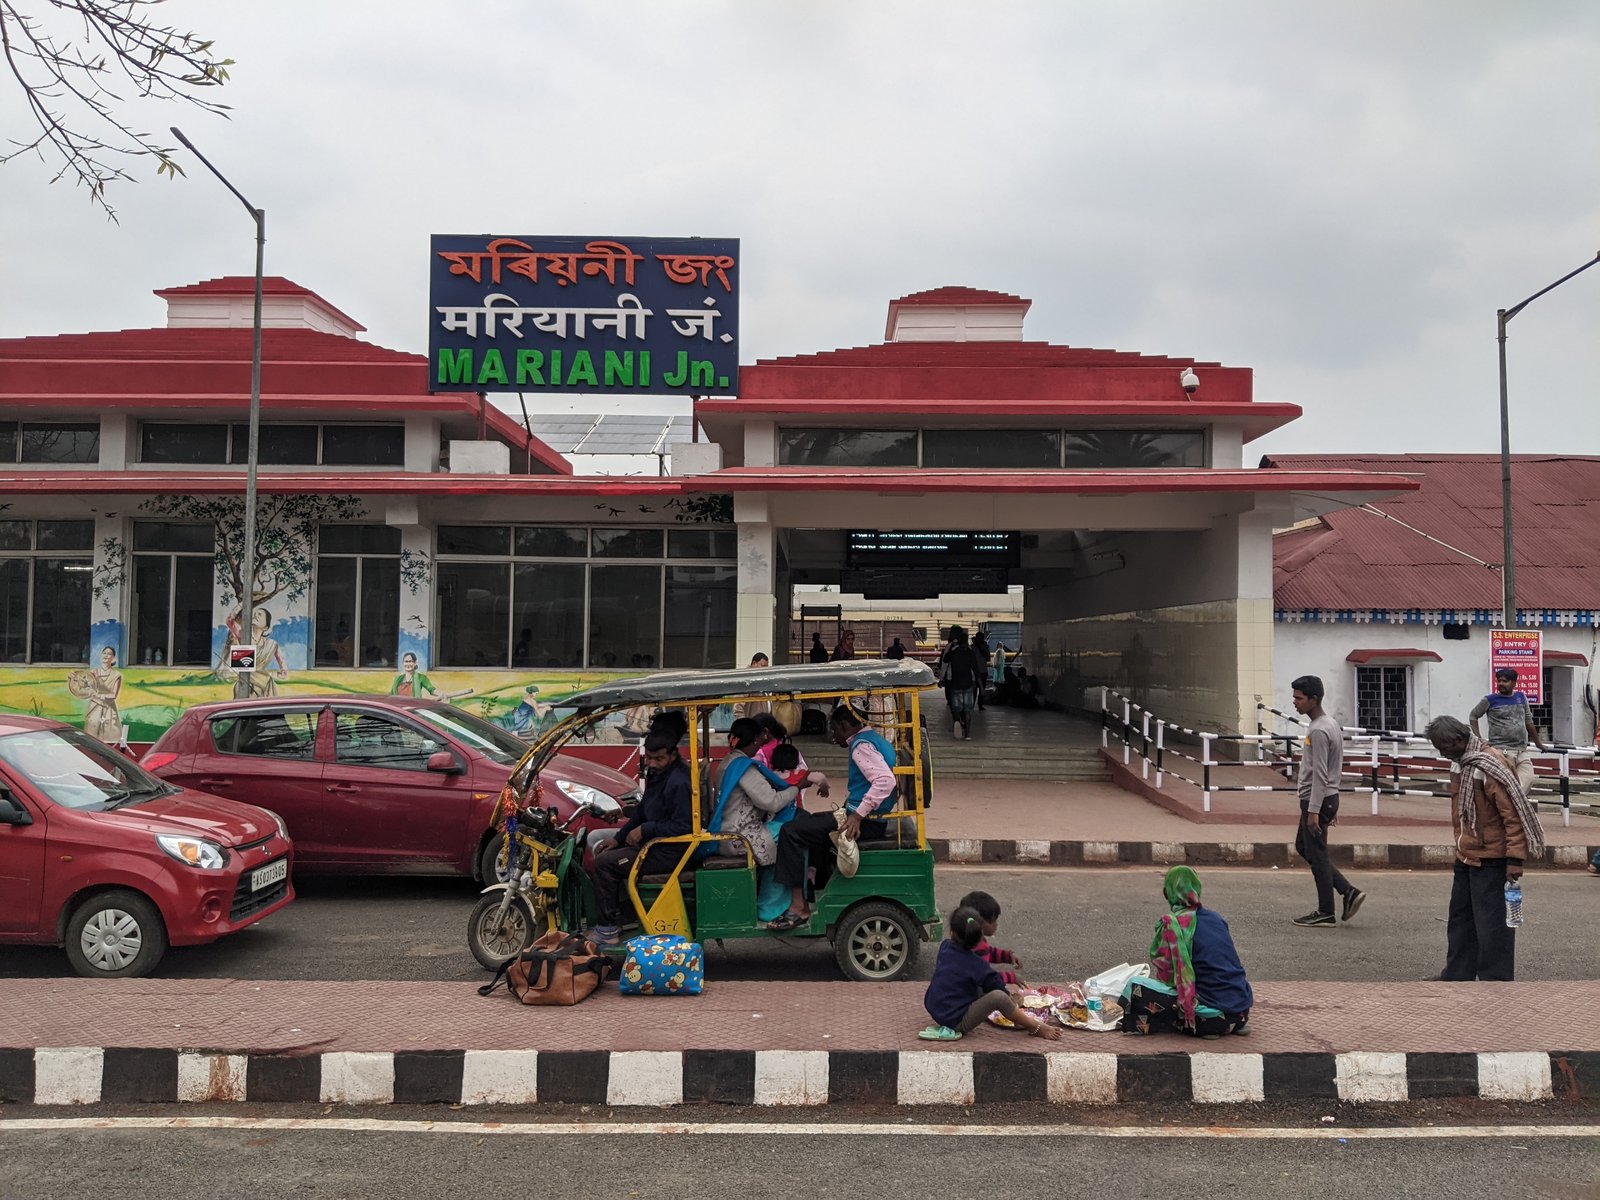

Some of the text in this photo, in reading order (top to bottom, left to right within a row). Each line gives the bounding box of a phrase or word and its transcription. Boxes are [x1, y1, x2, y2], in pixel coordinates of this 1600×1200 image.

[435, 293, 654, 341] मरियानी
[437, 348, 729, 388] MARIANI Jn.
[655, 919, 679, 932] G-7
